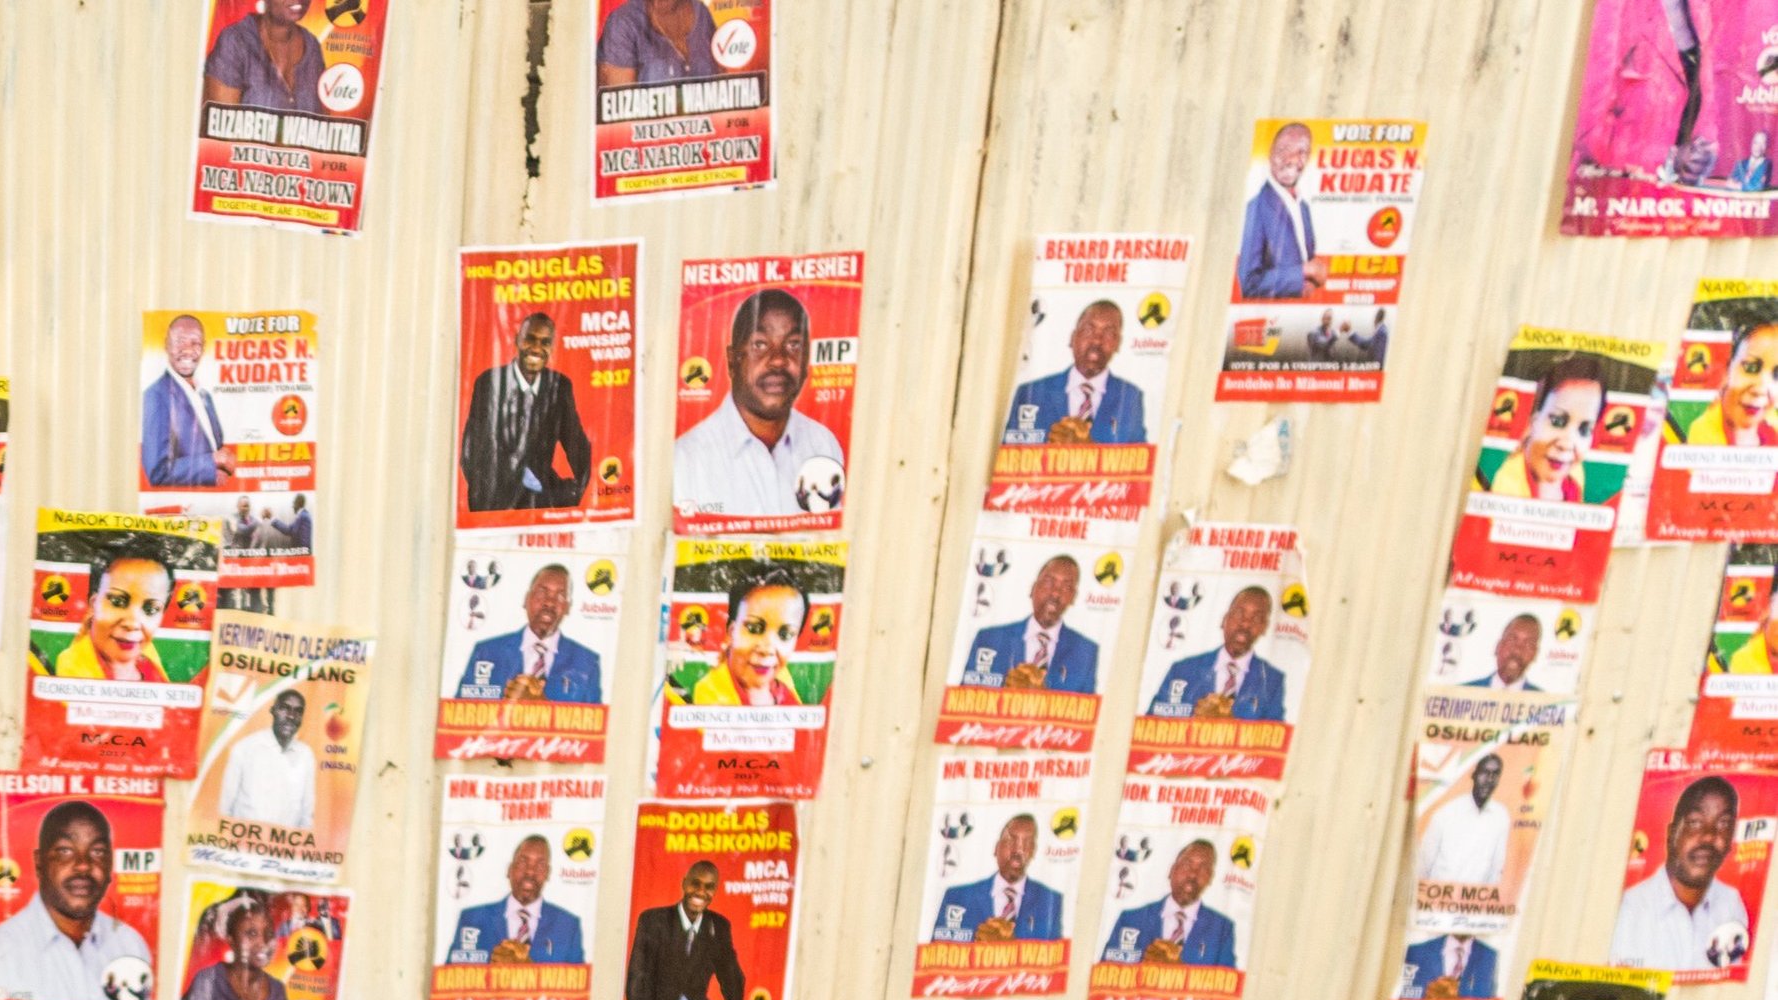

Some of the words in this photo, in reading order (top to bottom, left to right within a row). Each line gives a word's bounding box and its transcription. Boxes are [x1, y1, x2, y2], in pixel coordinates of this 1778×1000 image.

[324, 72, 358, 100] Vote
[601, 85, 677, 122] ELIZABETH
[208, 107, 279, 143] ELIZABETH
[634, 119, 713, 140] MUNYUA
[726, 118, 749, 128] FOR
[1376, 125, 1414, 141] FOR
[709, 138, 760, 161] TOWN
[1317, 149, 1395, 169] LUCAS
[1403, 149, 1421, 170] N.
[322, 161, 347, 171] FOR
[203, 168, 238, 191] MCA
[244, 171, 299, 197] NAROK
[305, 180, 355, 204] TOWN
[262, 203, 274, 213] WE
[277, 207, 293, 215] ARE
[1692, 197, 1771, 219] NORTH
[1045, 240, 1109, 260] BENARD
[495, 256, 604, 279] DOUGLAS
[684, 262, 759, 286] NELSON
[791, 256, 857, 279] KESHEI
[1064, 263, 1128, 283] TOROME
[1329, 255, 1400, 275] MCA
[494, 278, 631, 304] MASIKONDE
[226, 317, 265, 334] VOTE
[269, 316, 299, 333] FOR
[582, 312, 631, 332] MCA
[215, 339, 287, 360] LUCAS
[295, 339, 313, 359] N.
[563, 334, 631, 349] TOWNSHIP
[816, 340, 852, 363] MP
[590, 348, 631, 361] WARD
[219, 363, 308, 384] KUDATE
[590, 369, 631, 387] 2017
[237, 443, 312, 462] MCA
[1047, 447, 1098, 471] TOWN
[54, 511, 108, 527] NAROK
[114, 516, 158, 529] TOWN
[1030, 518, 1088, 539] TOROME
[580, 602, 617, 613] Jubilee
[299, 636, 322, 660] OLE
[220, 651, 299, 679] OSILIGI
[307, 665, 355, 684] LANG
[166, 689, 196, 701] SETH
[81, 733, 146, 747] M.C.A
[717, 759, 780, 769] M.C.A
[974, 762, 1029, 779] BENARD
[71, 776, 89, 793] K.
[667, 812, 769, 830] DOUGLAS
[219, 820, 262, 839] FOR
[270, 827, 315, 847] MCA
[665, 832, 792, 852] MASIKONDE
[187, 833, 241, 852] NAROK
[246, 841, 296, 860] TOWN
[302, 849, 344, 864] WARD
[123, 851, 154, 870] MP
[745, 860, 789, 879] MCA
[1461, 886, 1500, 901] MCA
[1440, 903, 1481, 915] TOWN
[1189, 967, 1238, 993] WARD
[1588, 968, 1624, 980] TOWN
